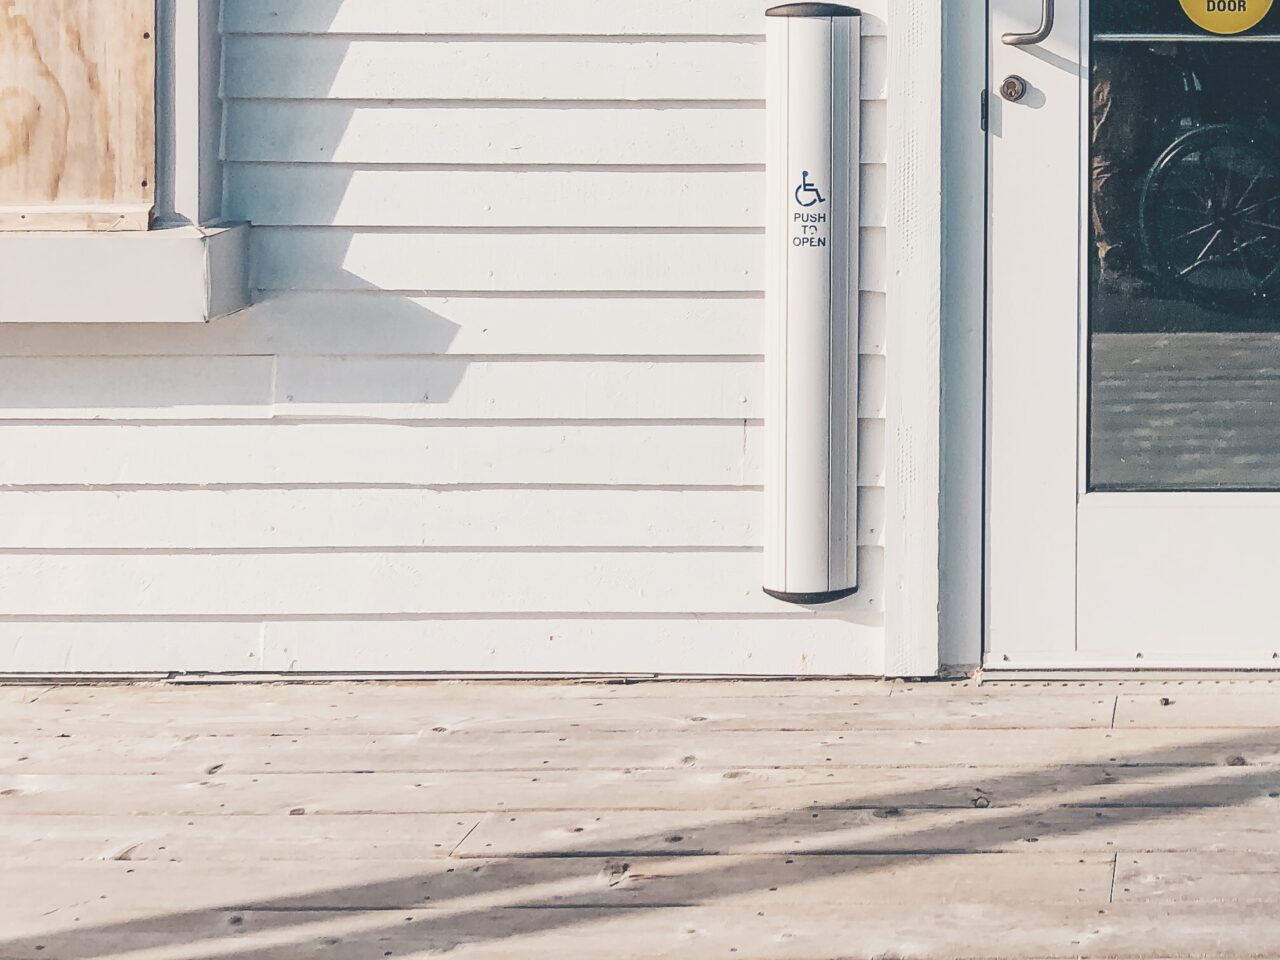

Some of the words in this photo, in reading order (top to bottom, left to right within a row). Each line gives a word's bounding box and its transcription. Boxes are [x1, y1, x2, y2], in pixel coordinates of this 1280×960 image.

[1206, 0, 1247, 12] DOOR
[794, 212, 826, 223] PUSH
[801, 224, 818, 235] TO
[793, 236, 826, 247] OPEN
